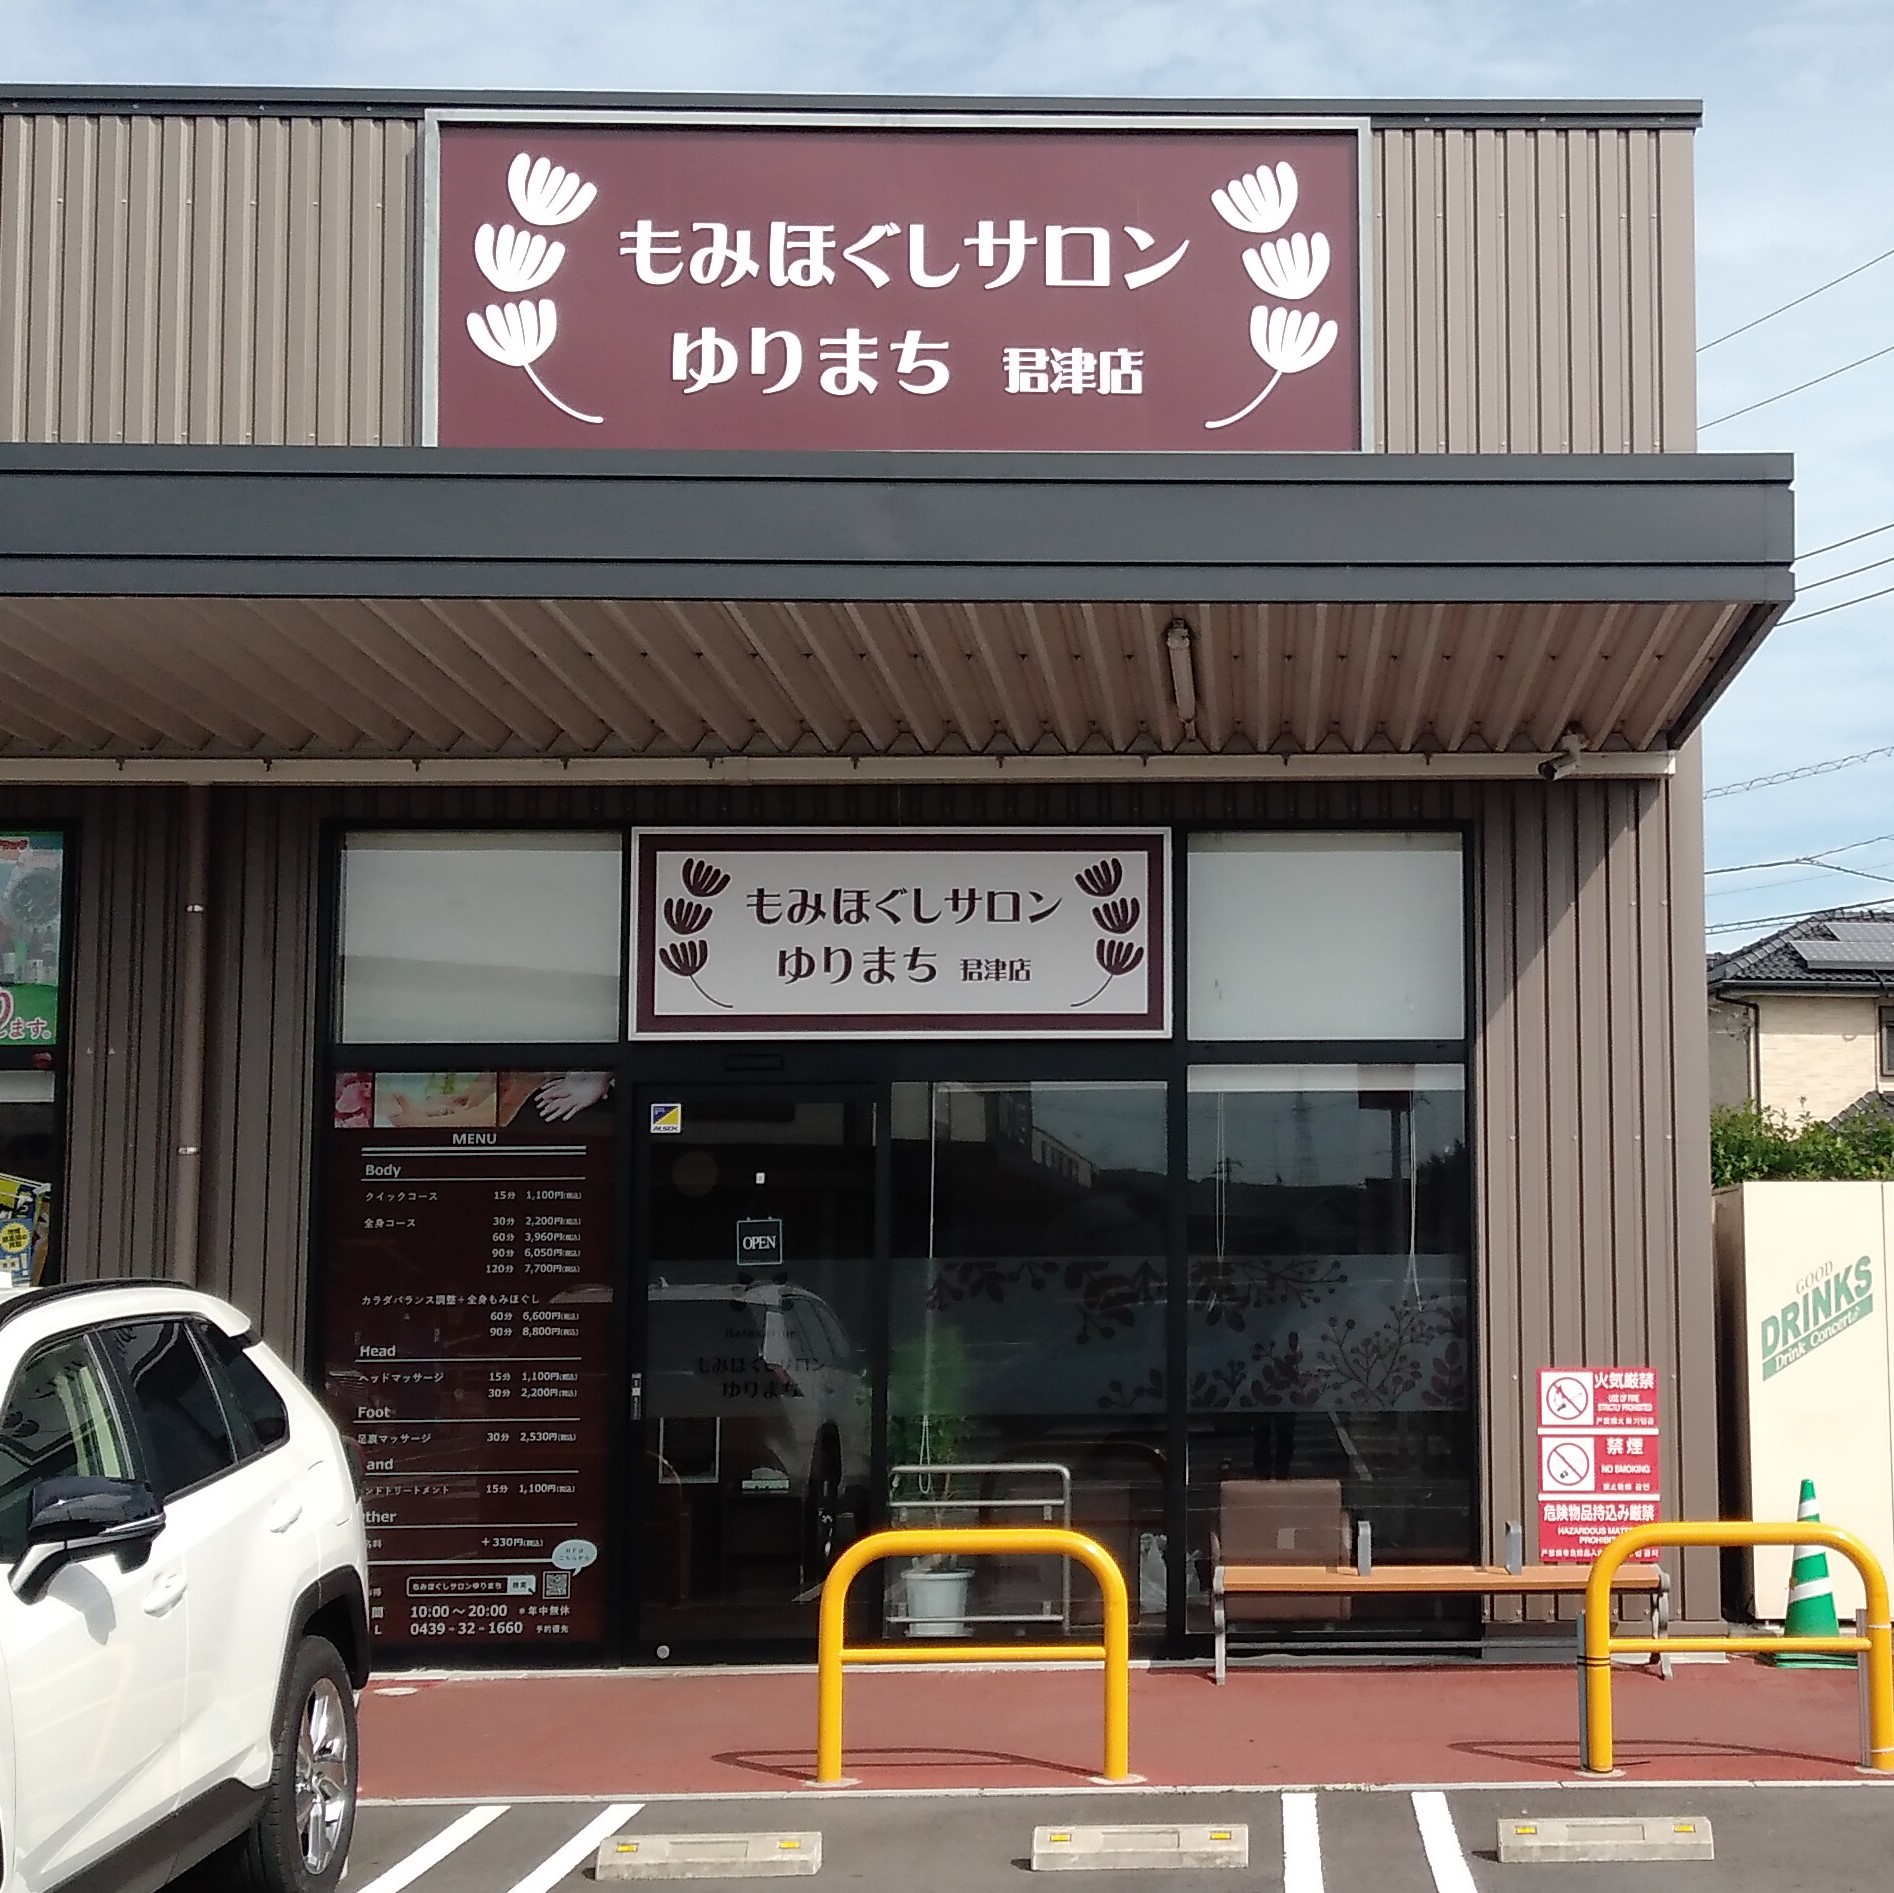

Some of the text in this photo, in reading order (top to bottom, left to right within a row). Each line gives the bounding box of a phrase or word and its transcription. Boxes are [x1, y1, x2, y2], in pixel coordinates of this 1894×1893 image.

[619, 219, 1190, 290] もみほぐしサロン
[672, 327, 1145, 395] ゆりまち 君津店
[746, 887, 1063, 925] もみほぐしサロン
[778, 946, 1031, 985] ゆりまち 君津店
[0, 1017, 51, 1040] ます。
[452, 1133, 497, 1144] MENU
[365, 1164, 401, 1178] Body
[365, 1192, 438, 1201] クイックコース
[494, 1191, 516, 1200] 15分
[364, 1218, 416, 1228] 全身コース
[492, 1217, 515, 1226] 30分
[492, 1233, 515, 1241] 60分
[743, 1235, 776, 1250] OPEN
[492, 1248, 514, 1258] 90分
[486, 1264, 514, 1273] 120分
[1796, 1261, 1833, 1295] GOOD
[1761, 1255, 1873, 1360] DRINKS
[490, 1312, 512, 1321] 60分
[490, 1328, 512, 1336] 90分
[1775, 1307, 1860, 1371] Drink Concerto
[359, 1345, 396, 1356] Head
[359, 1372, 444, 1383] ヘッドマッサージ
[489, 1372, 511, 1381] 15分
[1594, 1372, 1654, 1390] 火気厳禁
[488, 1389, 510, 1397] 30分
[358, 1406, 391, 1418] Foot
[358, 1433, 432, 1444] 足裏マッサージ
[487, 1432, 509, 1442] 30分
[1606, 1437, 1644, 1455] 禁煙
[367, 1459, 393, 1470] and
[1601, 1464, 1651, 1474] NO SMOKING
[365, 1487, 450, 1495] ンドトリートメント
[486, 1484, 508, 1493] 15分
[362, 1511, 396, 1523] ther
[1544, 1504, 1655, 1522] 危険物品持込み厳禁
[1558, 1526, 1607, 1536] HAZARDOUS
[1579, 1536, 1617, 1545] PROHIBIT
